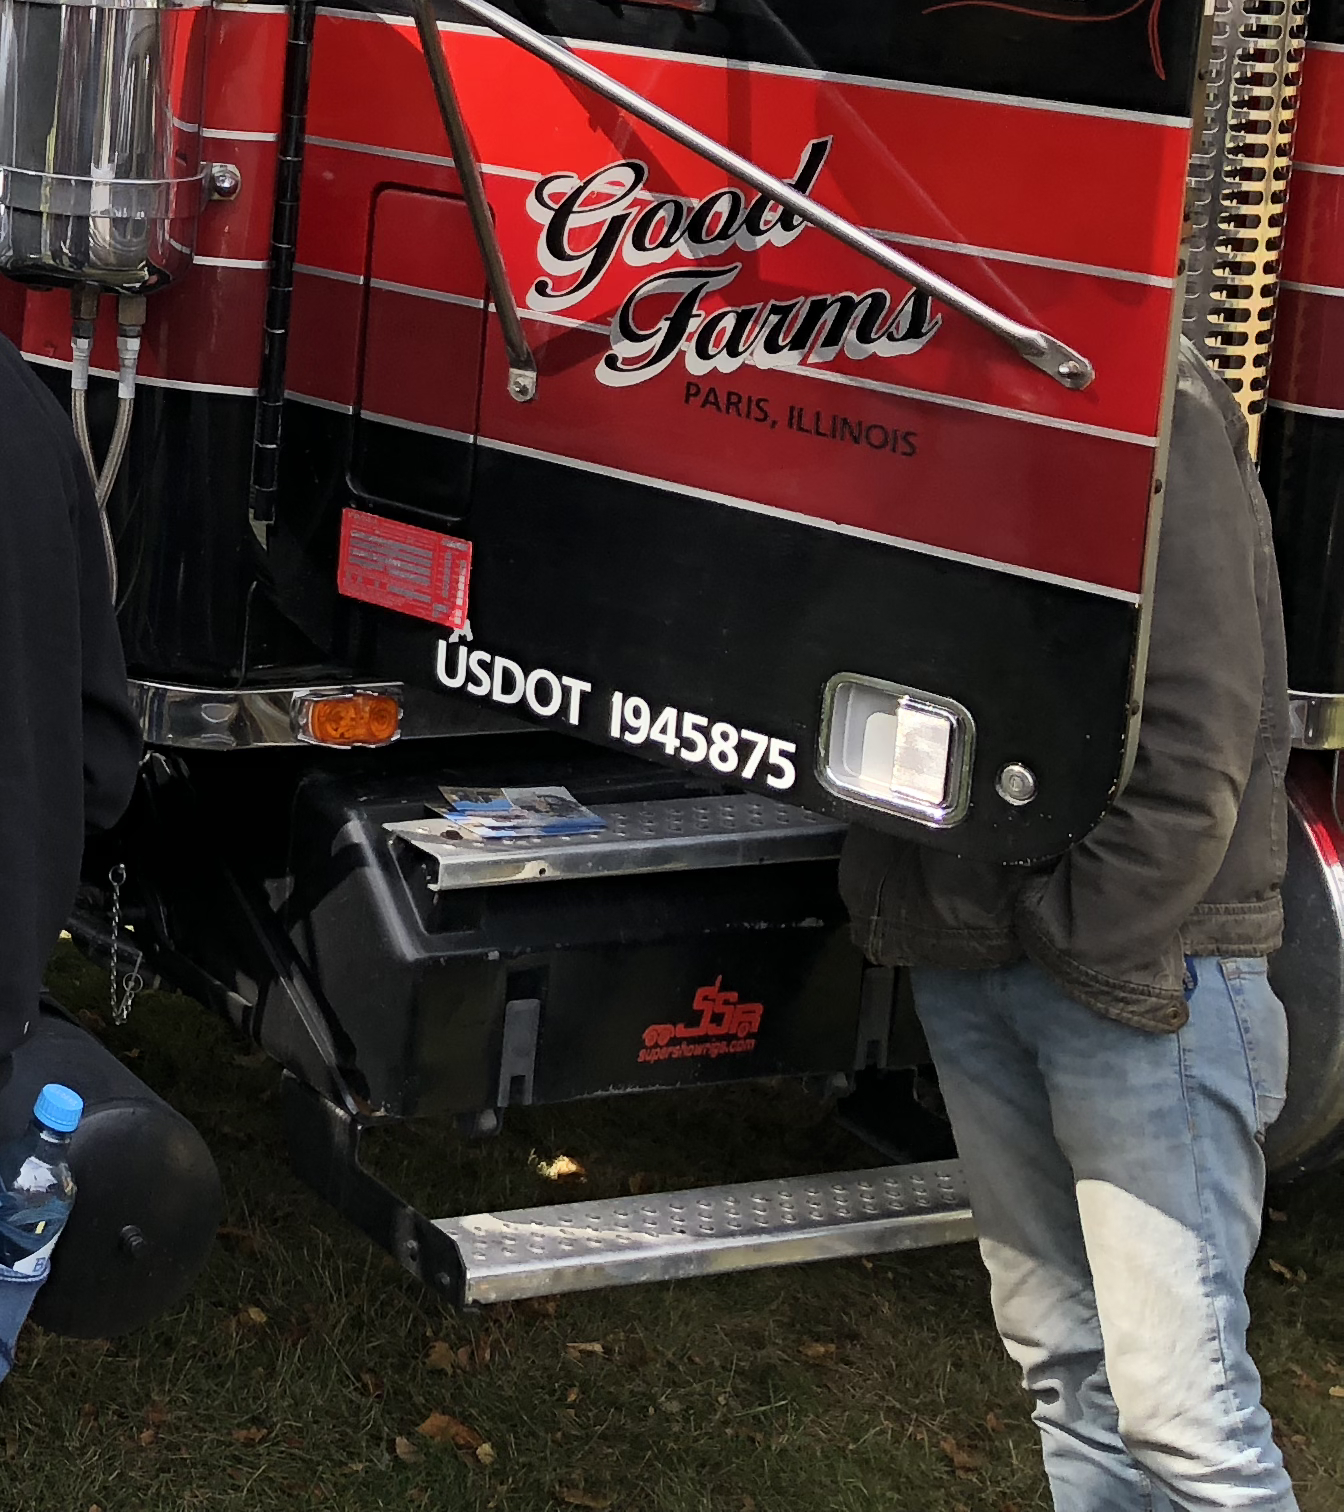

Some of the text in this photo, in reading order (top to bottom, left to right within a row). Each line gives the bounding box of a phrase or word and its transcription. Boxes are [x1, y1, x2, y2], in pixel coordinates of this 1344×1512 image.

[525, 134, 834, 312] Good
[594, 262, 943, 388] Farms
[683, 381, 918, 457] PARIS, ILLINOIS
[436, 639, 797, 791] USDOT 1945875
